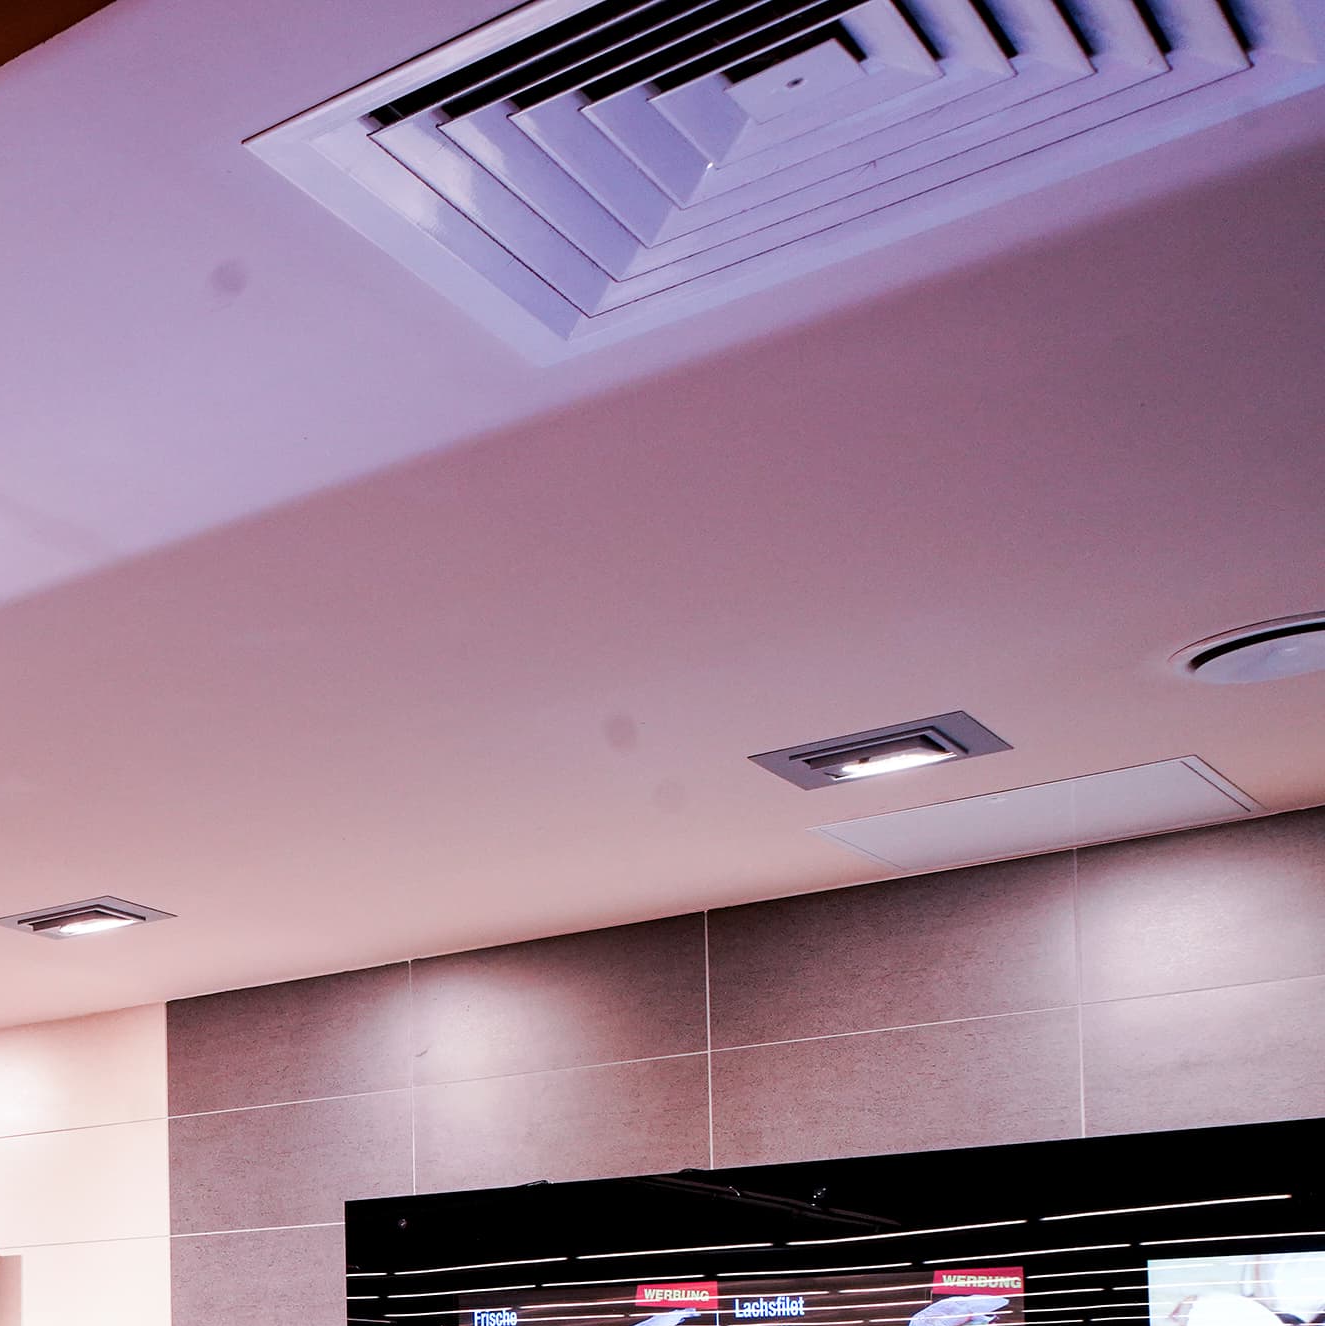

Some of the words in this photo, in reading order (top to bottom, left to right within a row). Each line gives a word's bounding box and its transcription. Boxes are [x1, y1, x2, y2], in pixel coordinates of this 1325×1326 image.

[942, 1274, 1022, 1289] WERBUNG
[643, 1288, 710, 1302] WERBUNG
[734, 1296, 805, 1318] Lachsfilet
